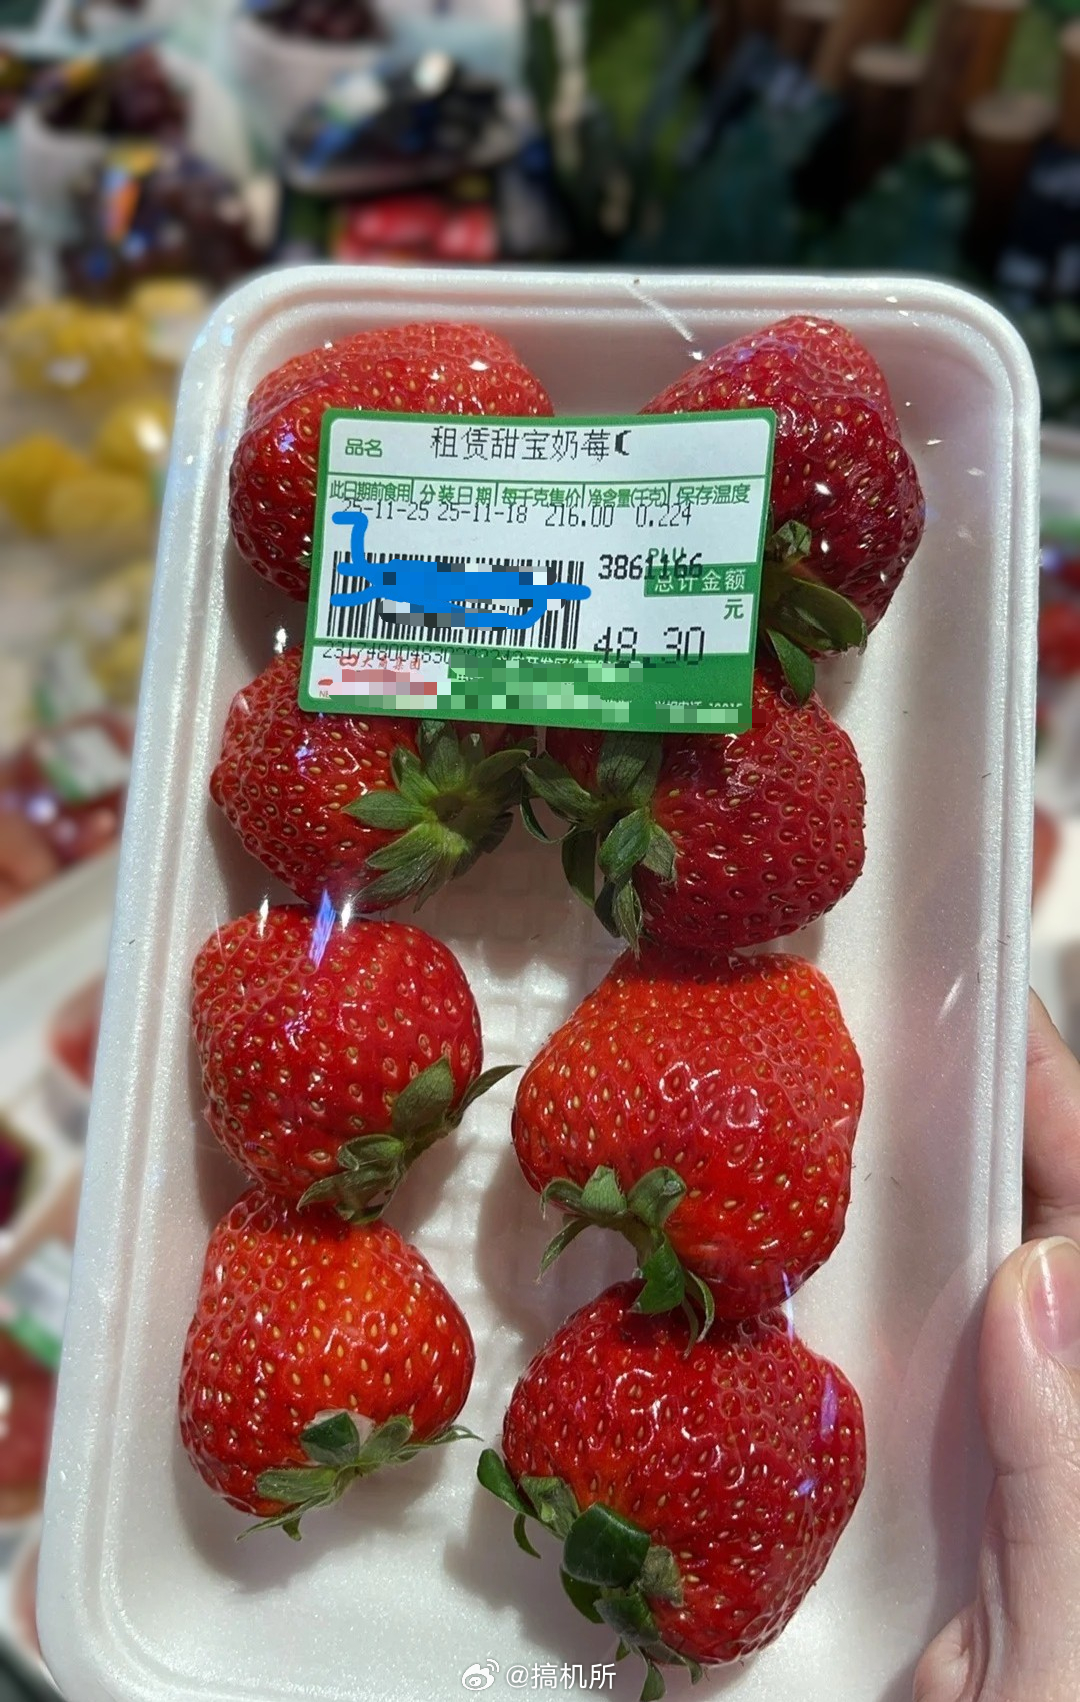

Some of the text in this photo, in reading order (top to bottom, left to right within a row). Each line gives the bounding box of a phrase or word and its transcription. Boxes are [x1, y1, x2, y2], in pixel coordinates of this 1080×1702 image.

[345, 438, 382, 458] 品名
[329, 480, 411, 502] 此日期前食用
[419, 484, 492, 506] 分装日期
[502, 486, 581, 508] 每千克售价
[676, 484, 751, 505] 保存温度
[341, 498, 692, 527] 25-11-25 25-11-18 216.00 0.224
[598, 553, 703, 580] 3861166
[654, 569, 746, 592] 总计金额
[723, 598, 744, 620] 元
[593, 626, 705, 665] 48.30
